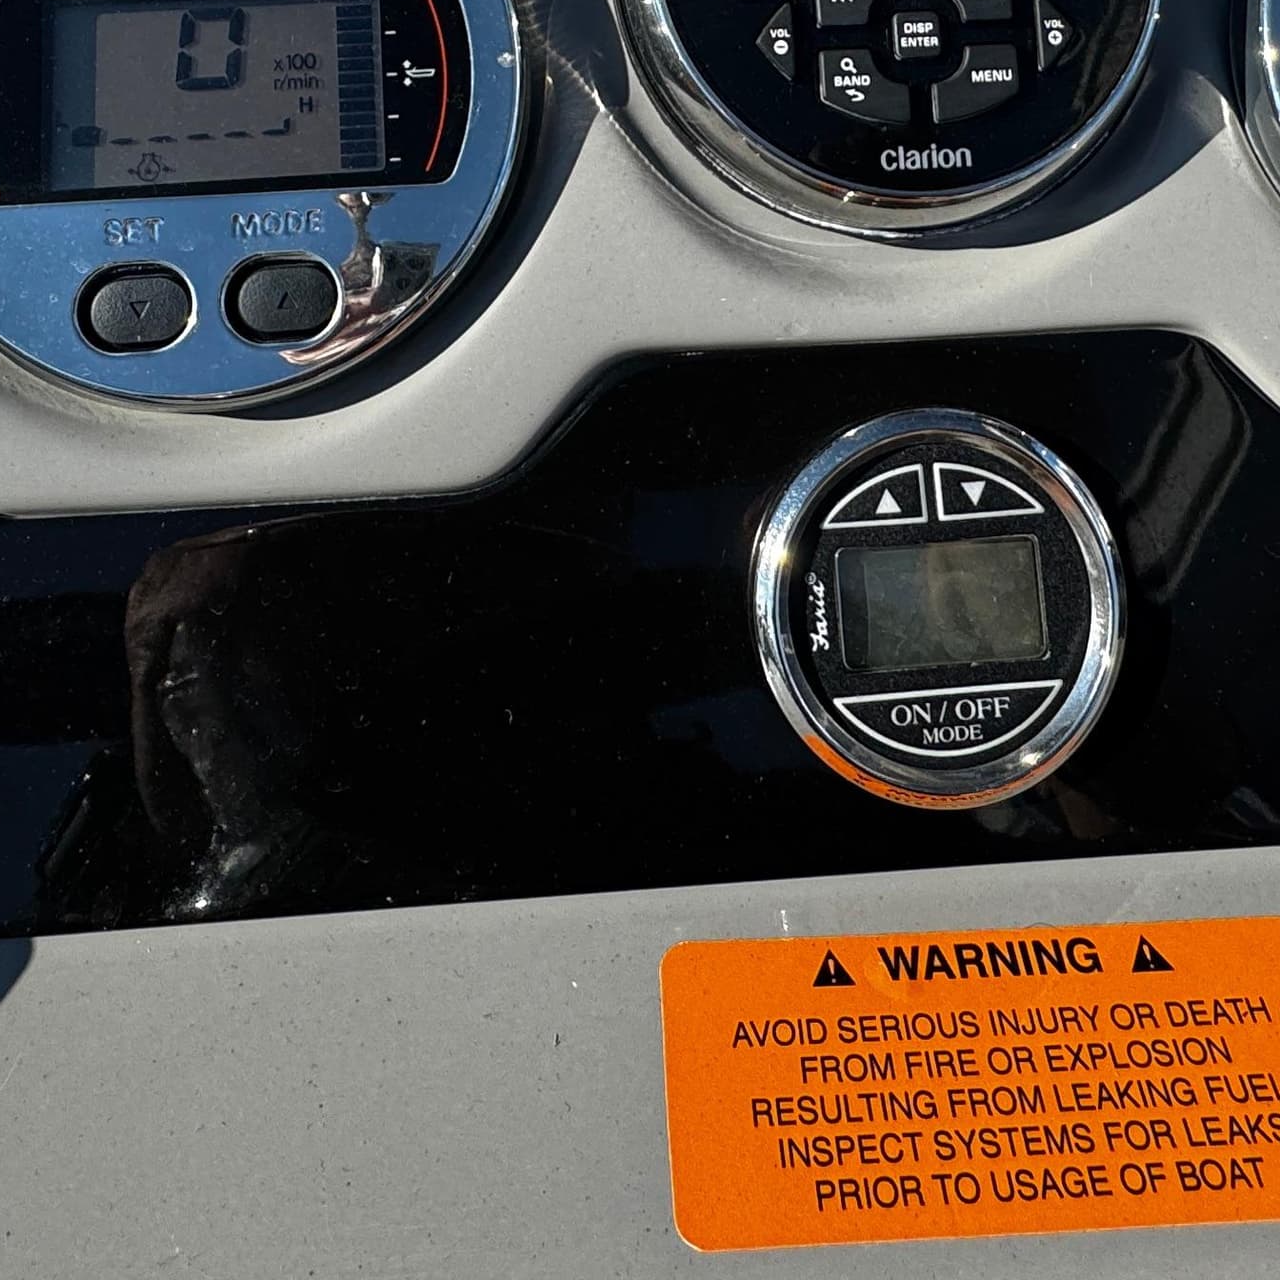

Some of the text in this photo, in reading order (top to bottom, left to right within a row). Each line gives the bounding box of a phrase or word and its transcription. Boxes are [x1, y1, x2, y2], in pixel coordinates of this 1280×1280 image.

[769, 28, 791, 40] VOL
[903, 22, 934, 36] DISP
[1044, 19, 1064, 30] VOL
[175, 5, 250, 92] 0
[900, 36, 939, 49] ENTER
[833, 74, 871, 89] BAND
[971, 68, 1013, 84] MENU
[298, 96, 315, 114] H
[880, 144, 972, 172] clarion
[103, 218, 165, 246] SET
[231, 210, 325, 239] MODE
[922, 724, 984, 745] MODE
[877, 936, 1104, 983] WARNING
[731, 996, 1272, 1049] AVOID SERIOUS INJURY OR DEATH
[800, 1036, 1233, 1083] FROM FIRE OR EXPLOSION
[751, 1090, 939, 1128] RESULTING
[948, 1085, 1046, 1118] FROM
[1055, 1077, 1198, 1113] LEAKING
[778, 1131, 923, 1170] INSPECT
[933, 1124, 1096, 1162] SYSTEMS
[1104, 1120, 1177, 1152] FOR
[815, 1155, 1267, 1212] PRIOR TO USAGE OF BOAT
